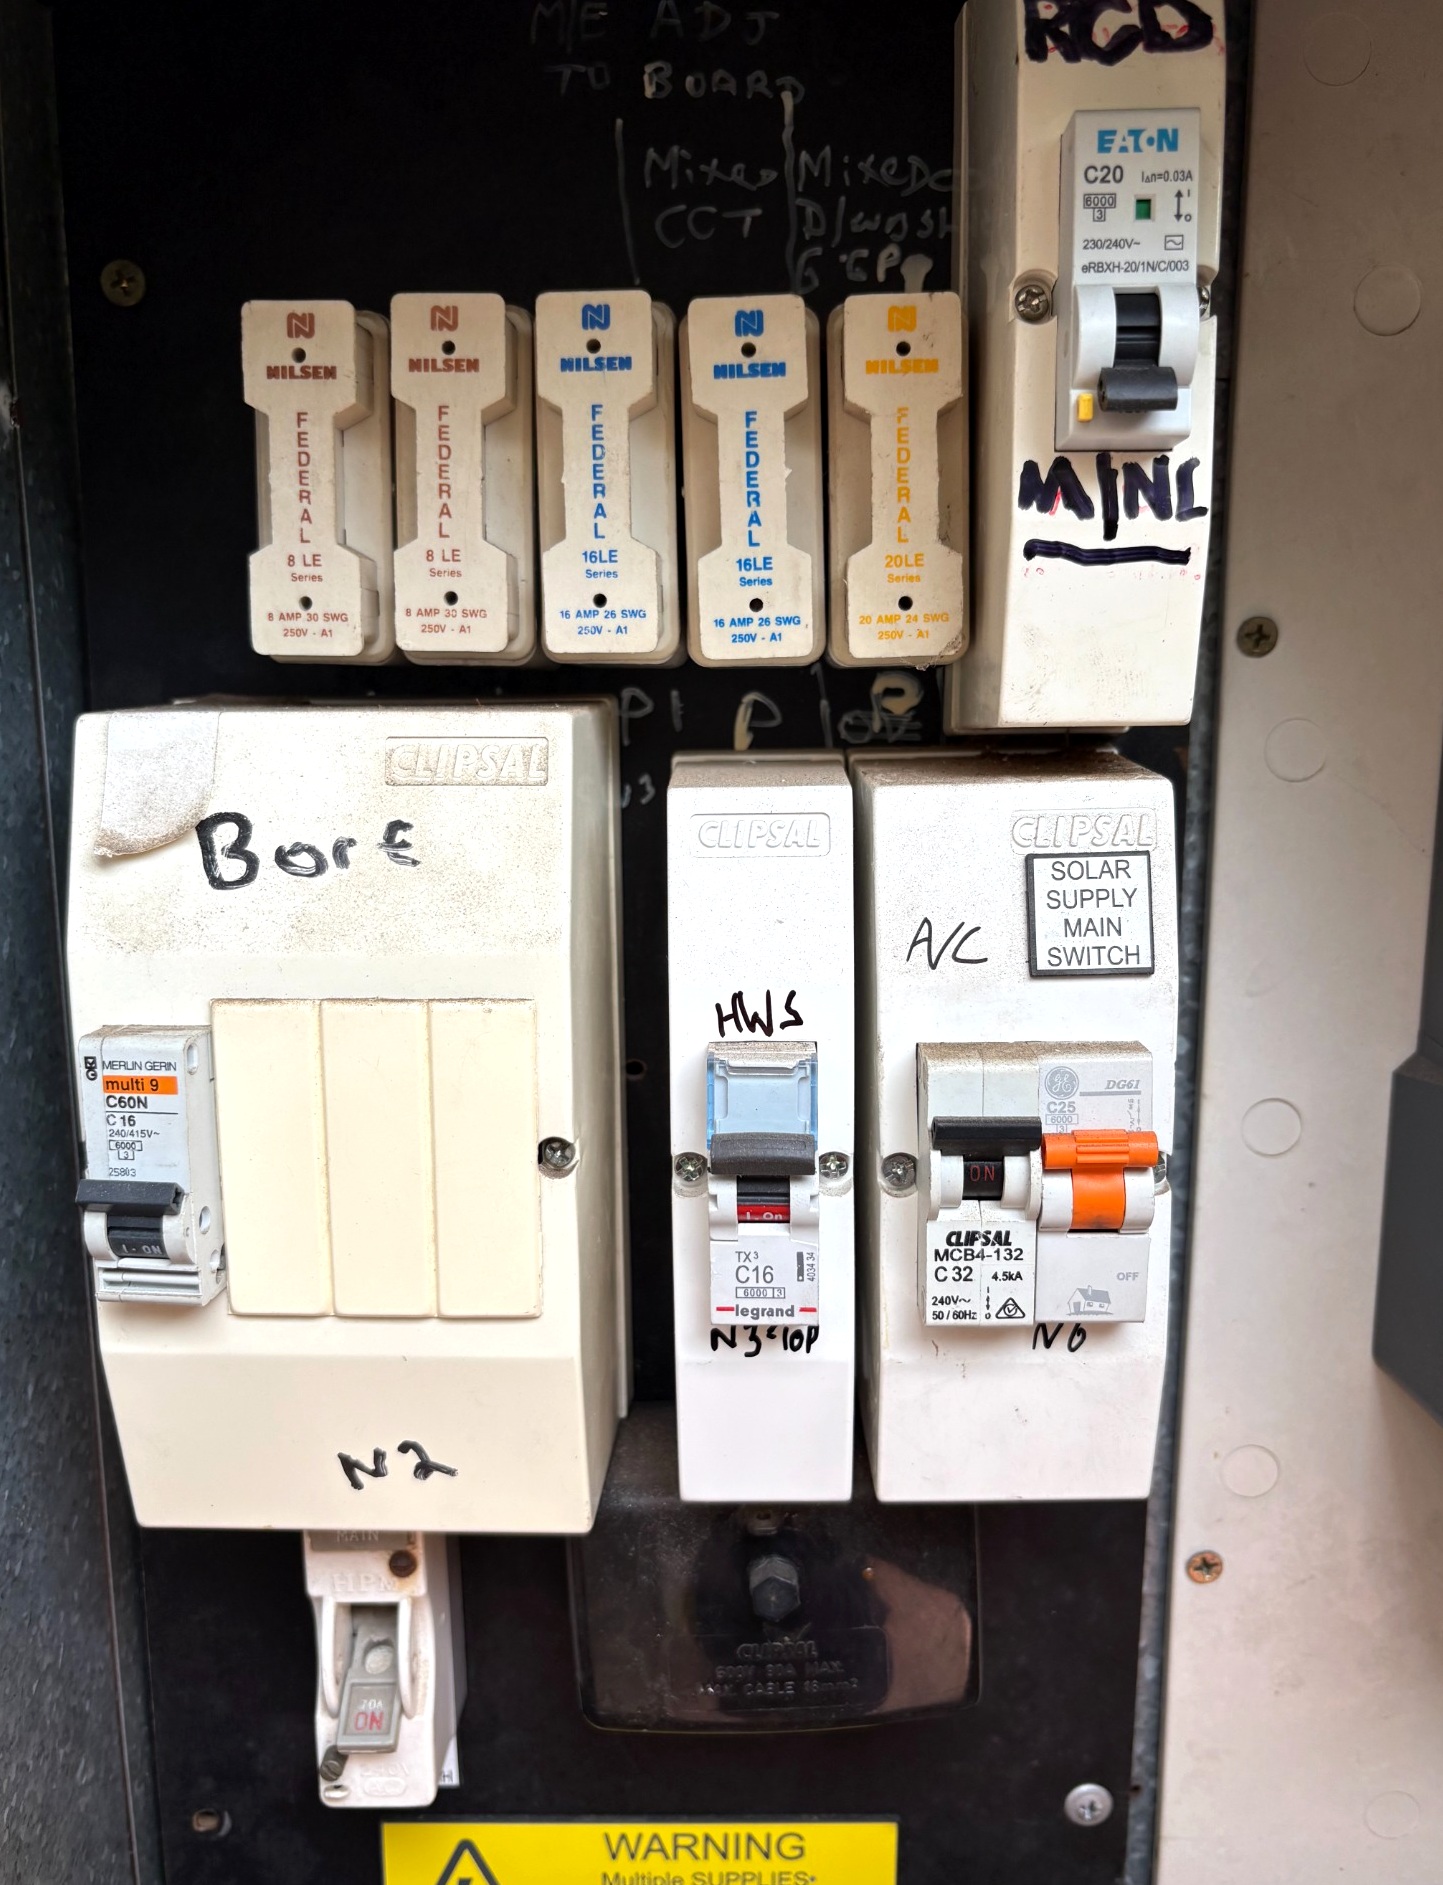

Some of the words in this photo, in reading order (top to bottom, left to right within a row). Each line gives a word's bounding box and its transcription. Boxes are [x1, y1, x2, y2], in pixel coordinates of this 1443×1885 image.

[1024, 0, 1213, 66] RCD
[1097, 128, 1179, 154] EATON
[1083, 165, 1124, 184] C20
[1085, 196, 1115, 207] 6000
[1096, 210, 1103, 220] 3
[1081, 261, 1190, 274] eRBXH-20/1N/C/003
[409, 359, 480, 373] NILSEN
[560, 357, 632, 372] NILSEN
[714, 362, 786, 379] NILSEN
[865, 359, 939, 374] NILSEN
[266, 365, 337, 380] NILSEN
[296, 412, 312, 543] FEDERAL
[438, 405, 452, 539] FEDERAL
[591, 404, 607, 539] FEDERAL
[897, 407, 911, 543] FEDERAL
[745, 411, 762, 547] FEDERAL
[288, 554, 296, 567] 8
[303, 554, 322, 567] LE
[426, 550, 434, 562] 8
[442, 550, 461, 562] LE
[582, 550, 618, 564] 16LE
[885, 554, 924, 569] 20LE
[736, 557, 773, 572] 16LE
[291, 572, 323, 583] Series
[429, 568, 462, 578] Series
[585, 569, 618, 579] Series
[887, 573, 921, 583] Series
[739, 577, 773, 587] Series
[267, 612, 274, 622] 8
[279, 612, 302, 622] AMP
[306, 612, 319, 622] 30
[323, 612, 348, 622] SWG
[406, 609, 412, 618] 8
[416, 609, 440, 618] AMP
[445, 609, 457, 618] 30
[462, 609, 488, 618] SWG
[560, 610, 570, 619] 16
[575, 609, 599, 619] AMP
[604, 609, 616, 619] 26
[621, 609, 646, 619] SWG
[859, 615, 872, 625] 20
[876, 614, 901, 625] AMP
[906, 614, 919, 624] 24
[923, 613, 950, 624] SWG
[421, 624, 447, 634] 250V
[459, 624, 471, 634] A1
[714, 618, 724, 628] 16
[729, 617, 754, 628] AMP
[758, 617, 771, 627] 26
[775, 616, 801, 627] SWG
[283, 629, 308, 638] 250V
[321, 629, 333, 638] A1
[577, 626, 603, 635] 250V
[615, 626, 628, 635] A1
[878, 630, 903, 640] 250V
[916, 630, 929, 639] A1
[731, 633, 757, 643] 250V
[770, 633, 782, 642] A1
[391, 741, 544, 782] CLIPSAL
[698, 819, 821, 849] CLIPSAL
[1012, 814, 1152, 848] CLIPSAL
[1051, 860, 1131, 881] SOLAR
[1046, 888, 1137, 910] SUPPLY
[1064, 917, 1122, 938] MAIN
[1047, 945, 1140, 967] SWITCH
[715, 989, 804, 1037] HWS
[102, 1060, 143, 1071] MERLIN
[145, 1061, 177, 1071] GERIN
[106, 1078, 145, 1091] multi
[150, 1079, 159, 1092] 9
[106, 1095, 148, 1109] C60N
[1046, 1101, 1076, 1114] C25
[106, 1114, 117, 1126] C
[120, 1115, 136, 1127] 16
[1050, 1115, 1073, 1124] 6000
[115, 1141, 137, 1150] 6000
[124, 1151, 129, 1160] 3
[969, 1166, 996, 1182] ON
[945, 1229, 1013, 1247] CLIPSAL
[806, 1252, 816, 1261] 34
[934, 1248, 1024, 1262] MCB4-132
[735, 1264, 774, 1284] C16
[806, 1263, 816, 1282] 4034
[934, 1265, 948, 1282] C
[951, 1265, 974, 1282] 32
[991, 1271, 1024, 1282] 4.5kA
[1117, 1271, 1140, 1282] OFF
[743, 1288, 768, 1297] 6000
[776, 1288, 783, 1297] 3
[735, 1304, 795, 1320] legrand
[932, 1310, 944, 1320] 50
[952, 1310, 977, 1320] 60Hz
[353, 1712, 384, 1731] ON
[603, 1832, 806, 1861] WARNING
